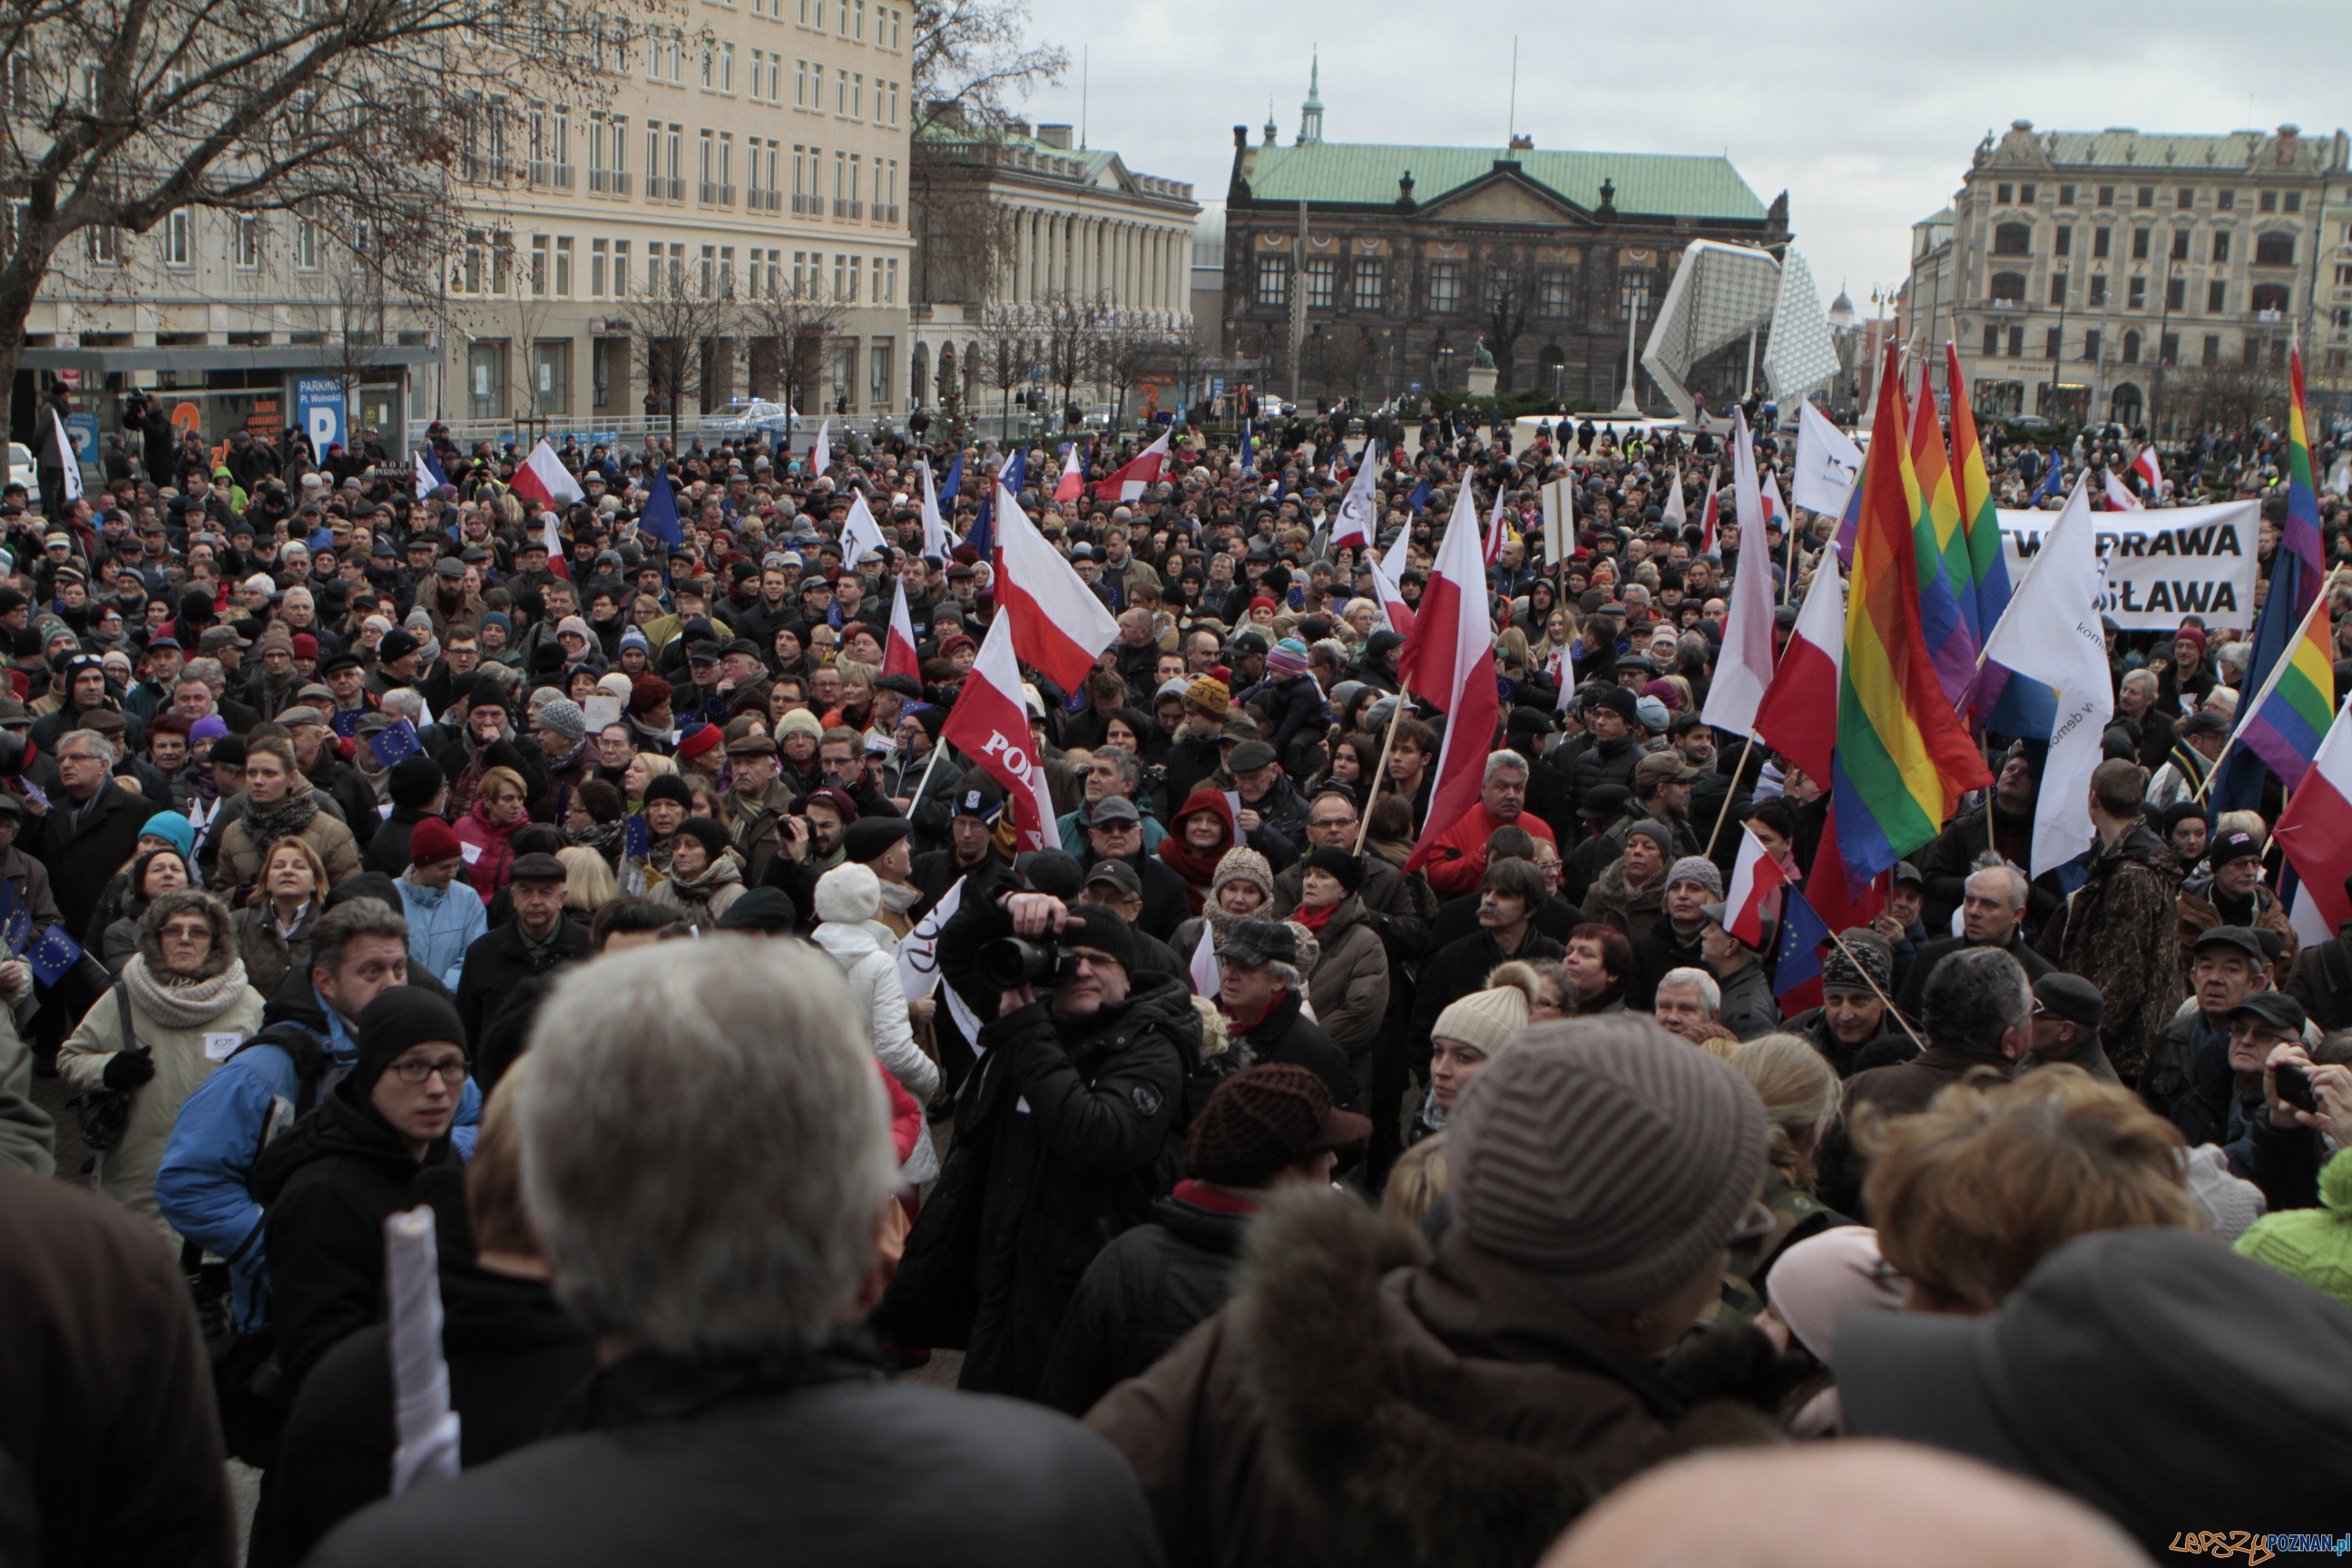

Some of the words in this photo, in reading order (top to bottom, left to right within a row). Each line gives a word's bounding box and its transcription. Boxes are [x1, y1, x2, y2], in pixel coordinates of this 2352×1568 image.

[300, 378, 340, 393] PARKING
[255, 401, 276, 413] BIURO
[309, 407, 337, 465] P
[381, 460, 407, 468] KOD
